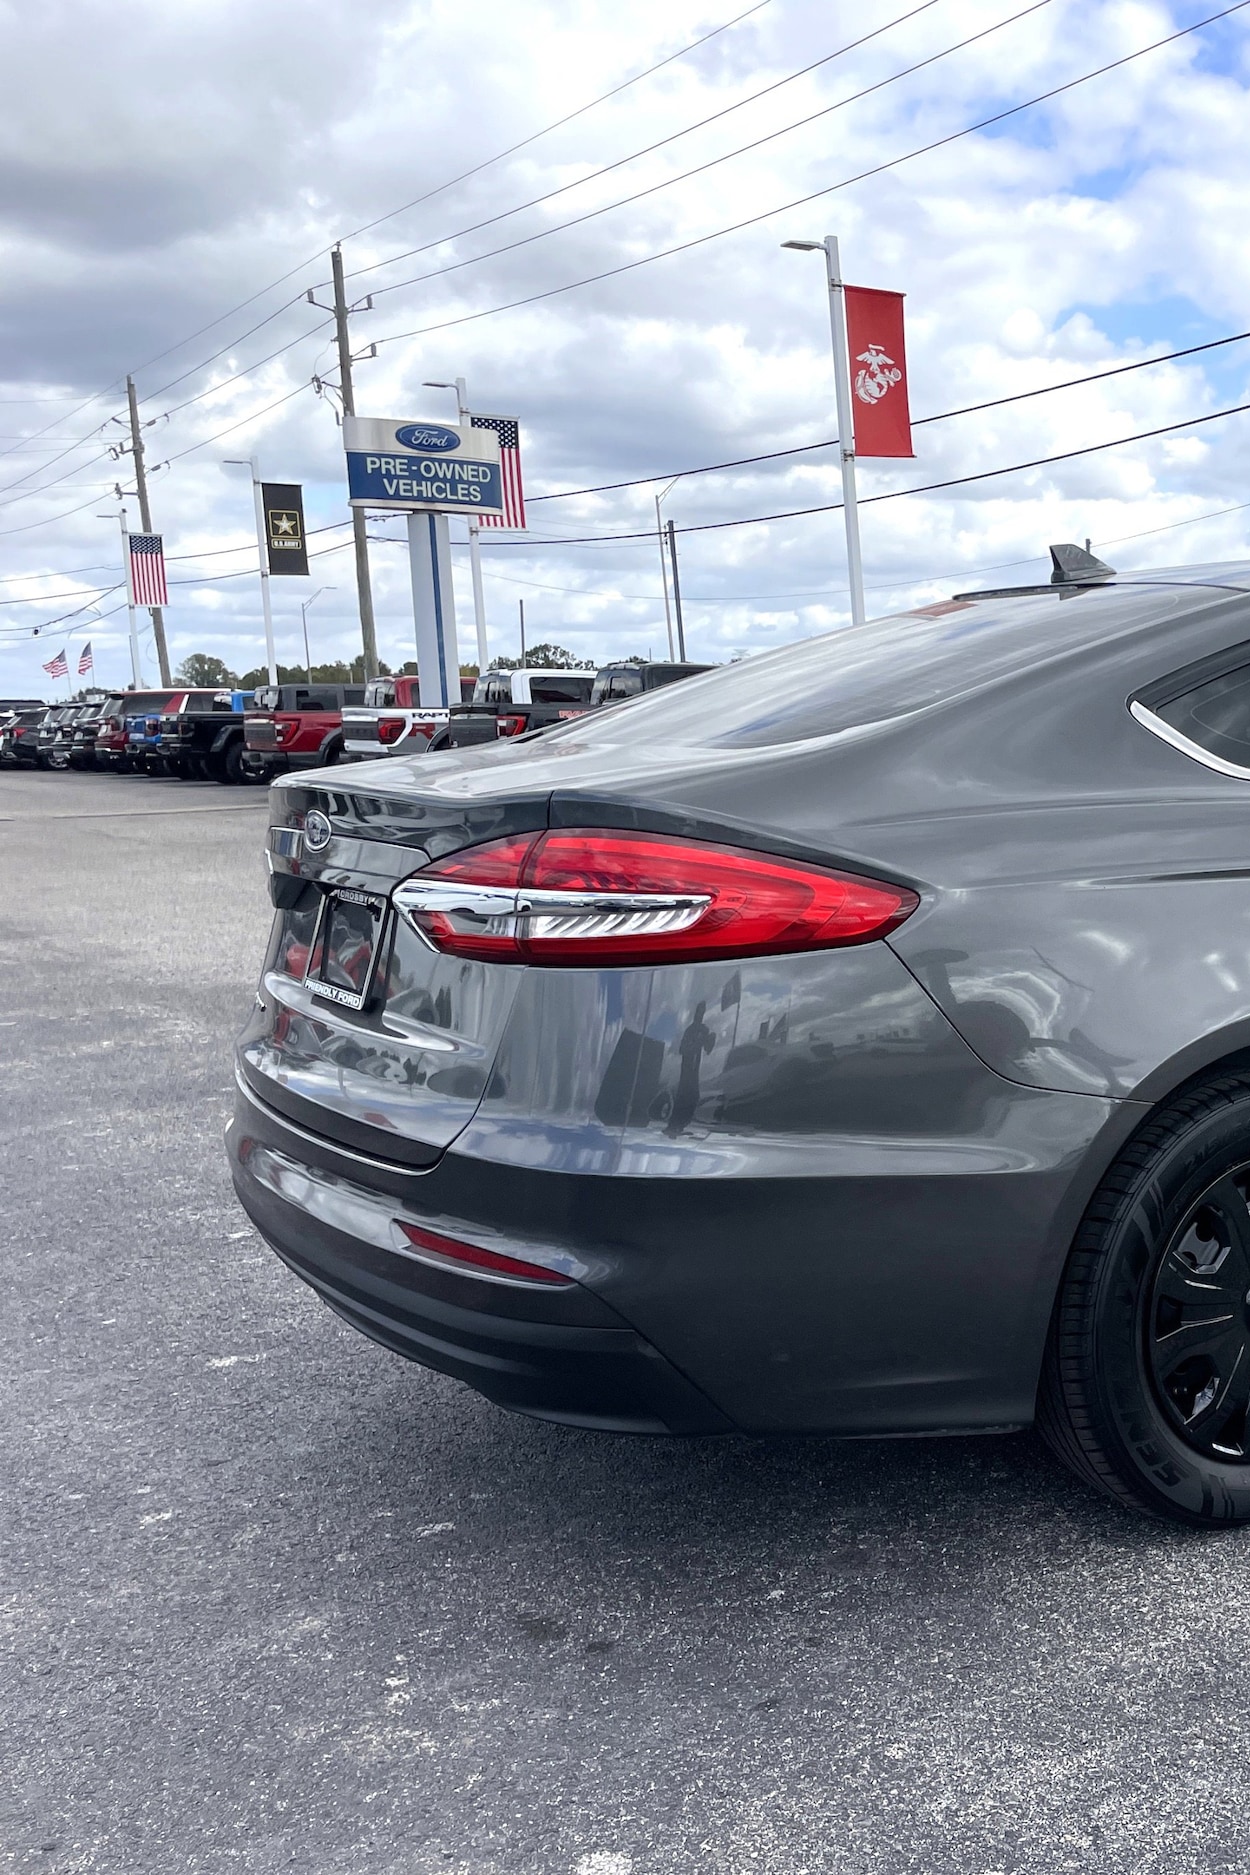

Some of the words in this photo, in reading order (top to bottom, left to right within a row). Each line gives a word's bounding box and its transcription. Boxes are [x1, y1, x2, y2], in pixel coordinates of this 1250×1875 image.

[411, 427, 449, 447] Ford
[382, 478, 482, 502] VEHICLES
[339, 890, 369, 904] CROSBY
[305, 981, 338, 998] FRIENDLY
[337, 994, 361, 1008] FORD
